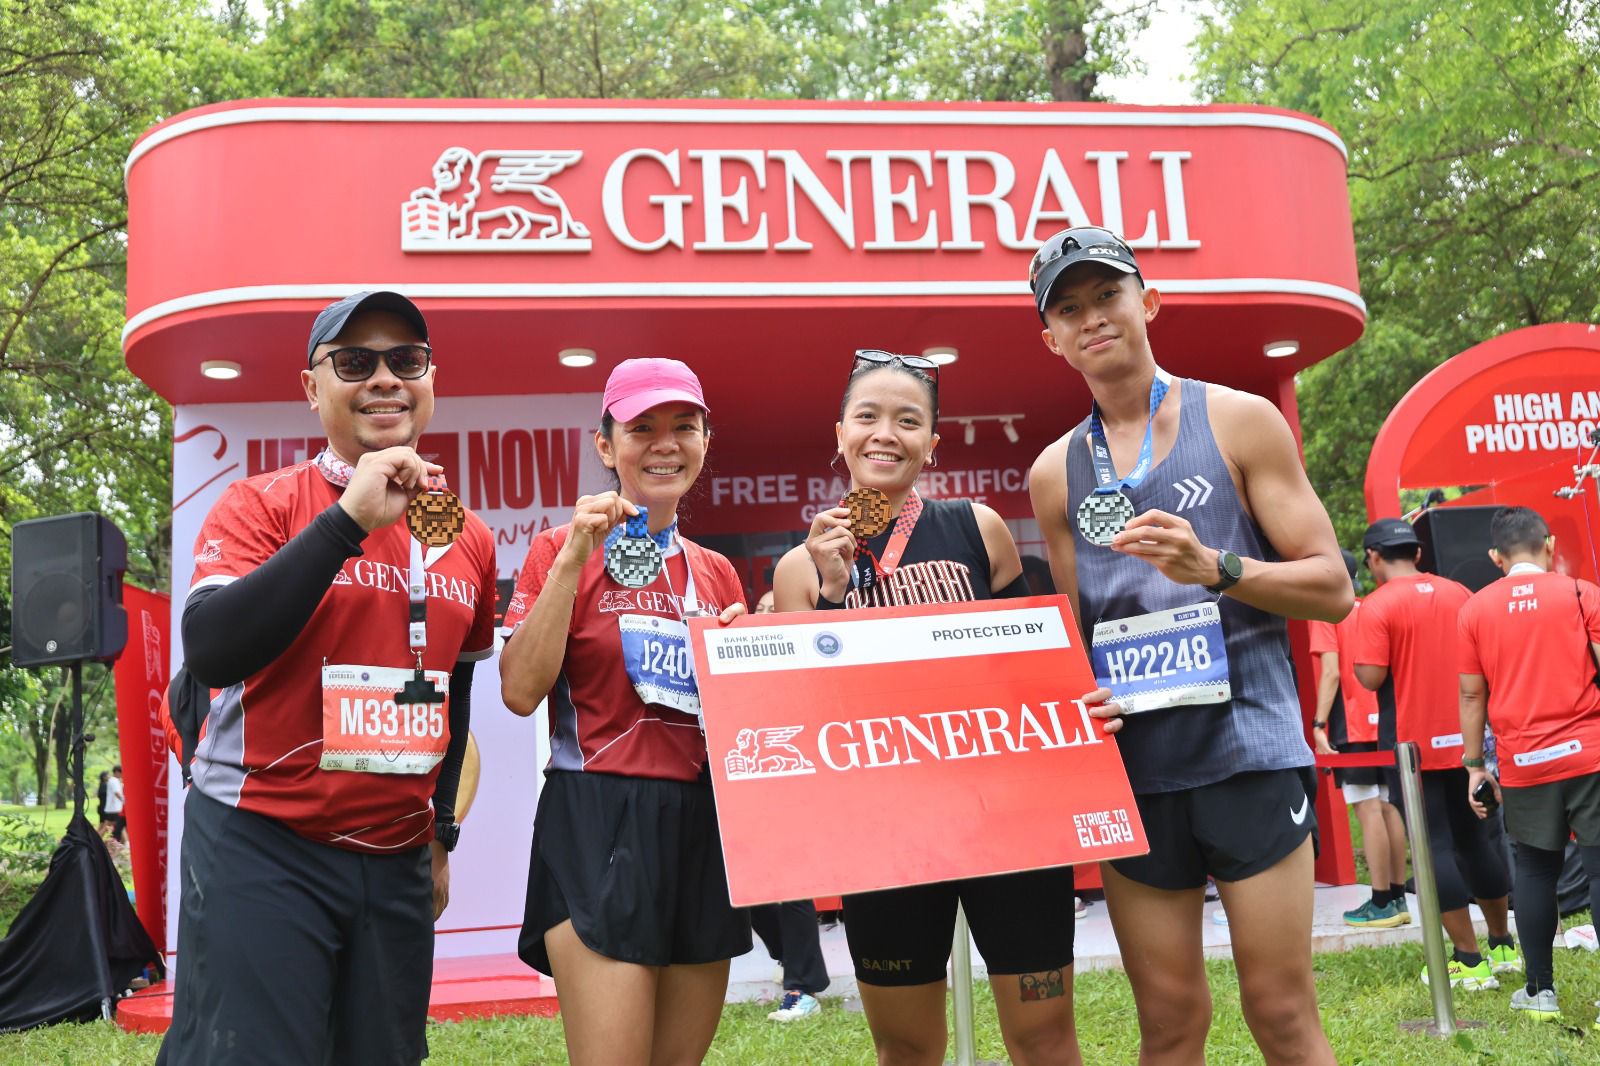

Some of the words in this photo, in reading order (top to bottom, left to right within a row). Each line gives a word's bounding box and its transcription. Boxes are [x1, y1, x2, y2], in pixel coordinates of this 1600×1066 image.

[602, 148, 1201, 251] GENERALI
[1088, 248, 1119, 256] 2XU
[1493, 392, 1563, 422] HIGH
[1465, 420, 1600, 454] PHOTOBO
[467, 428, 582, 510] NOW
[712, 474, 799, 505] FREE
[807, 475, 852, 501] RA
[915, 468, 1030, 496] ERTIFIC
[1508, 598, 1538, 613] FFH
[724, 636, 748, 644] BANK
[750, 633, 784, 643] JATENG
[932, 624, 1022, 641] PROTECTED
[1025, 622, 1044, 634] BY
[716, 641, 796, 660] BOROBUDUR
[1106, 634, 1212, 685] H22248
[340, 697, 444, 738] M33185
[817, 699, 1103, 771] GENERALI
[1072, 811, 1112, 828] STRIDE
[1112, 808, 1128, 823] TO
[1077, 822, 1135, 848] GLORY
[861, 958, 913, 971] SAINT
